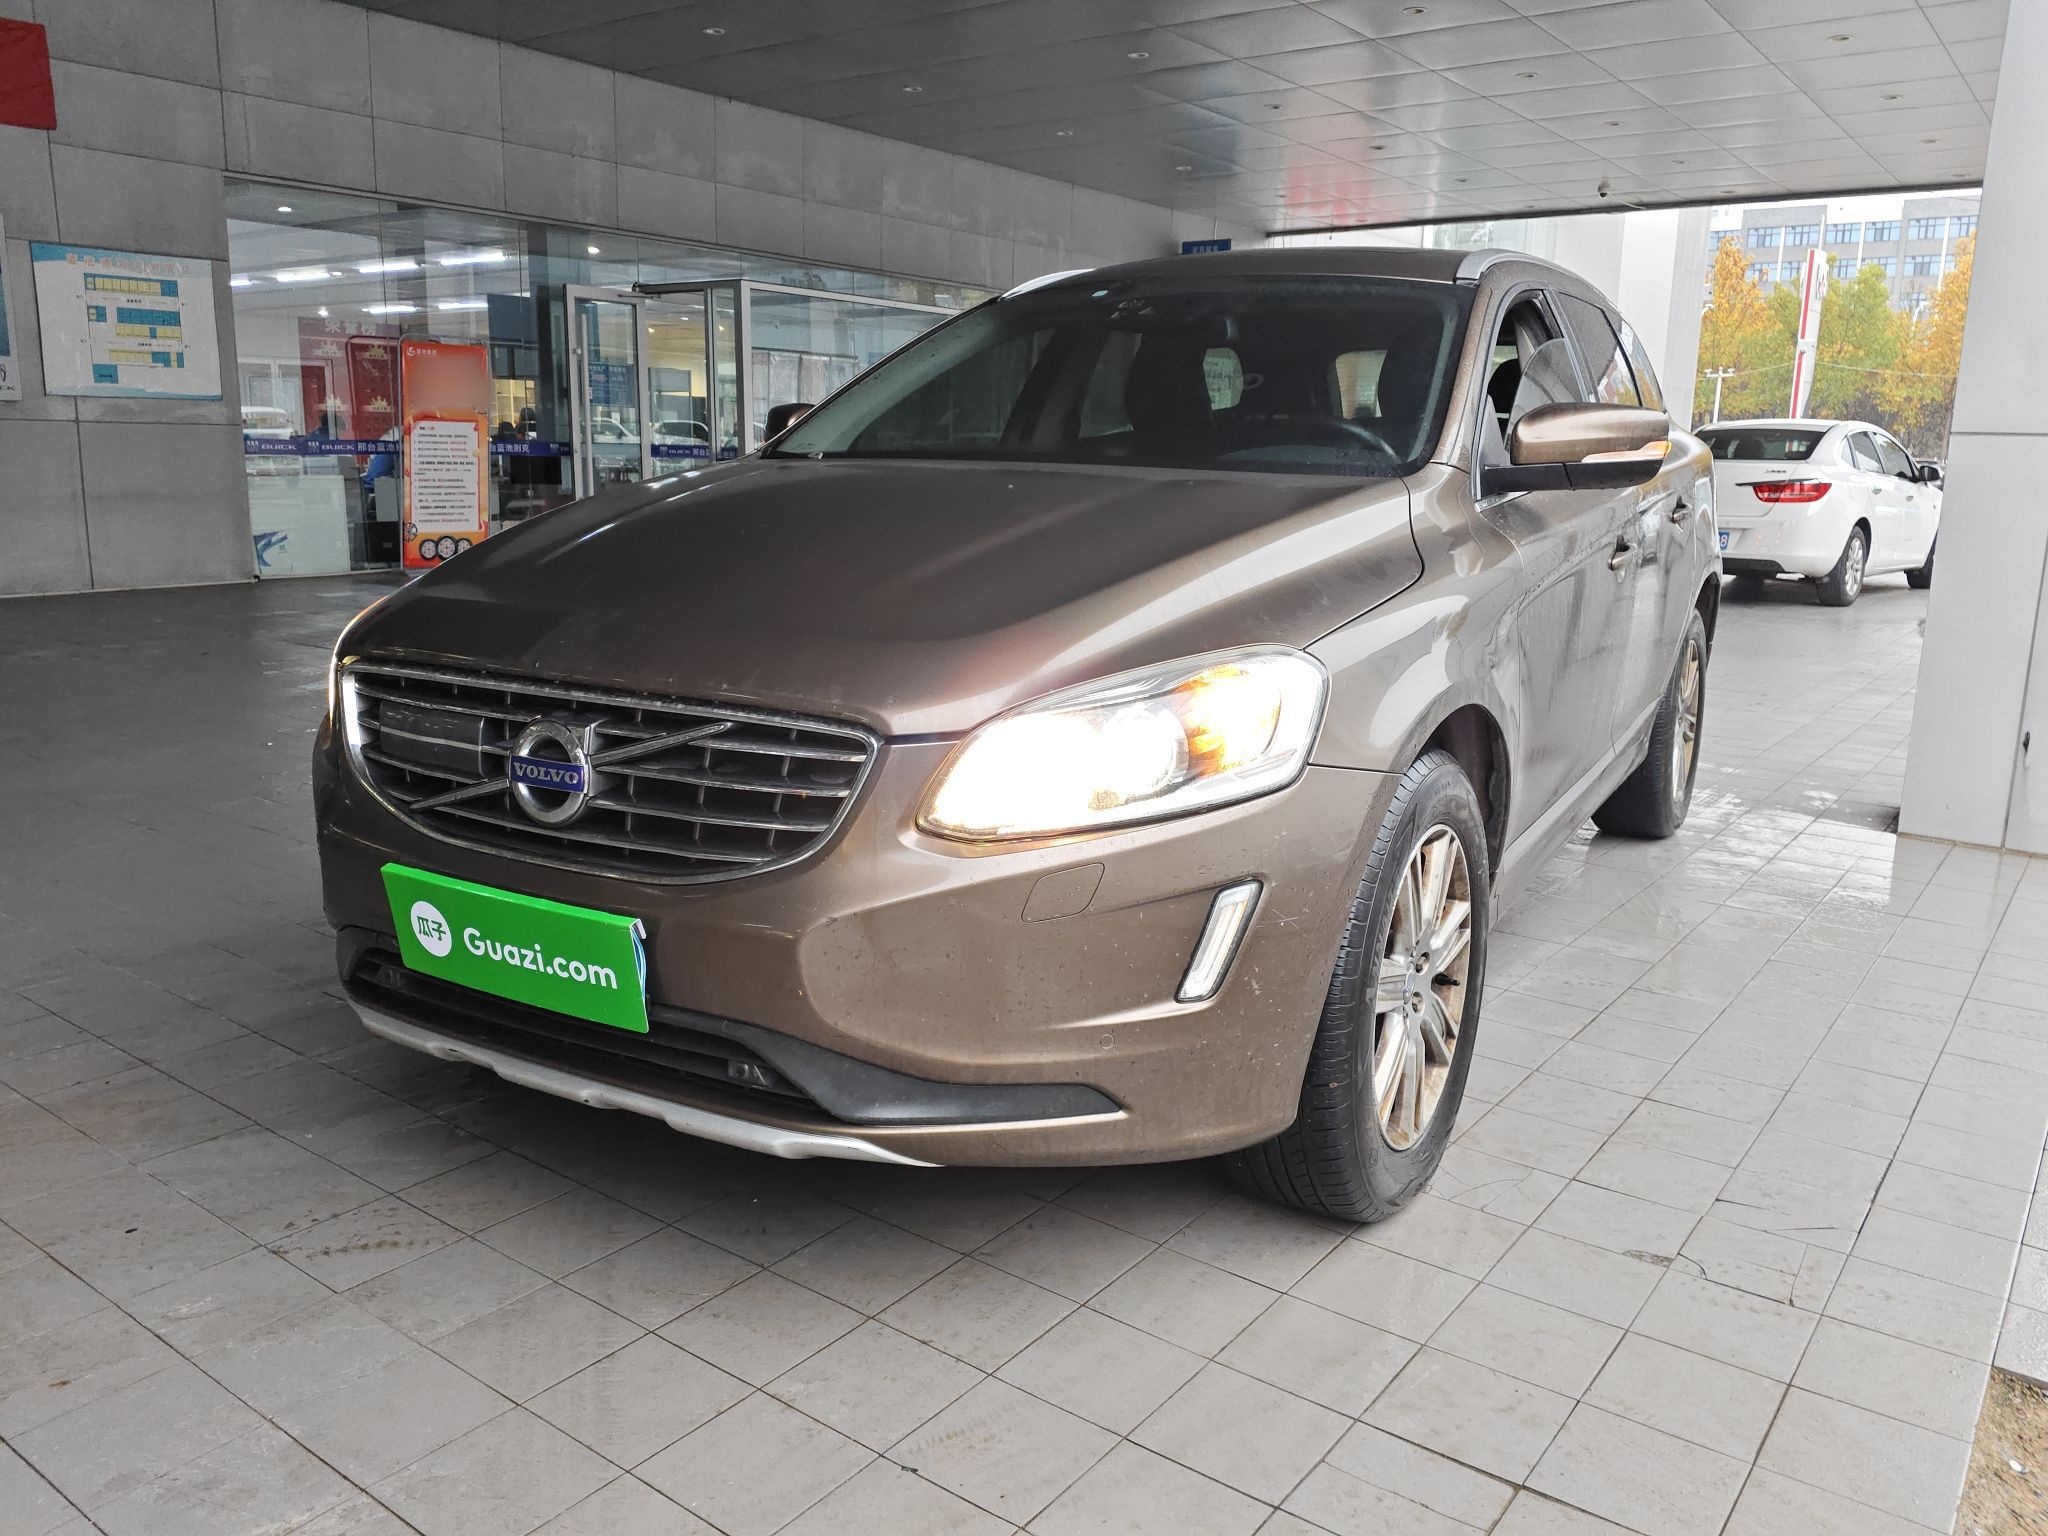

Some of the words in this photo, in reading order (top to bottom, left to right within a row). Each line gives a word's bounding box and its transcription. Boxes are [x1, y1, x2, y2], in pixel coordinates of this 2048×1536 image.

[513, 762, 579, 785] VOLVO
[416, 915, 447, 942] 瓜子
[463, 927, 618, 990] Guazi.com
